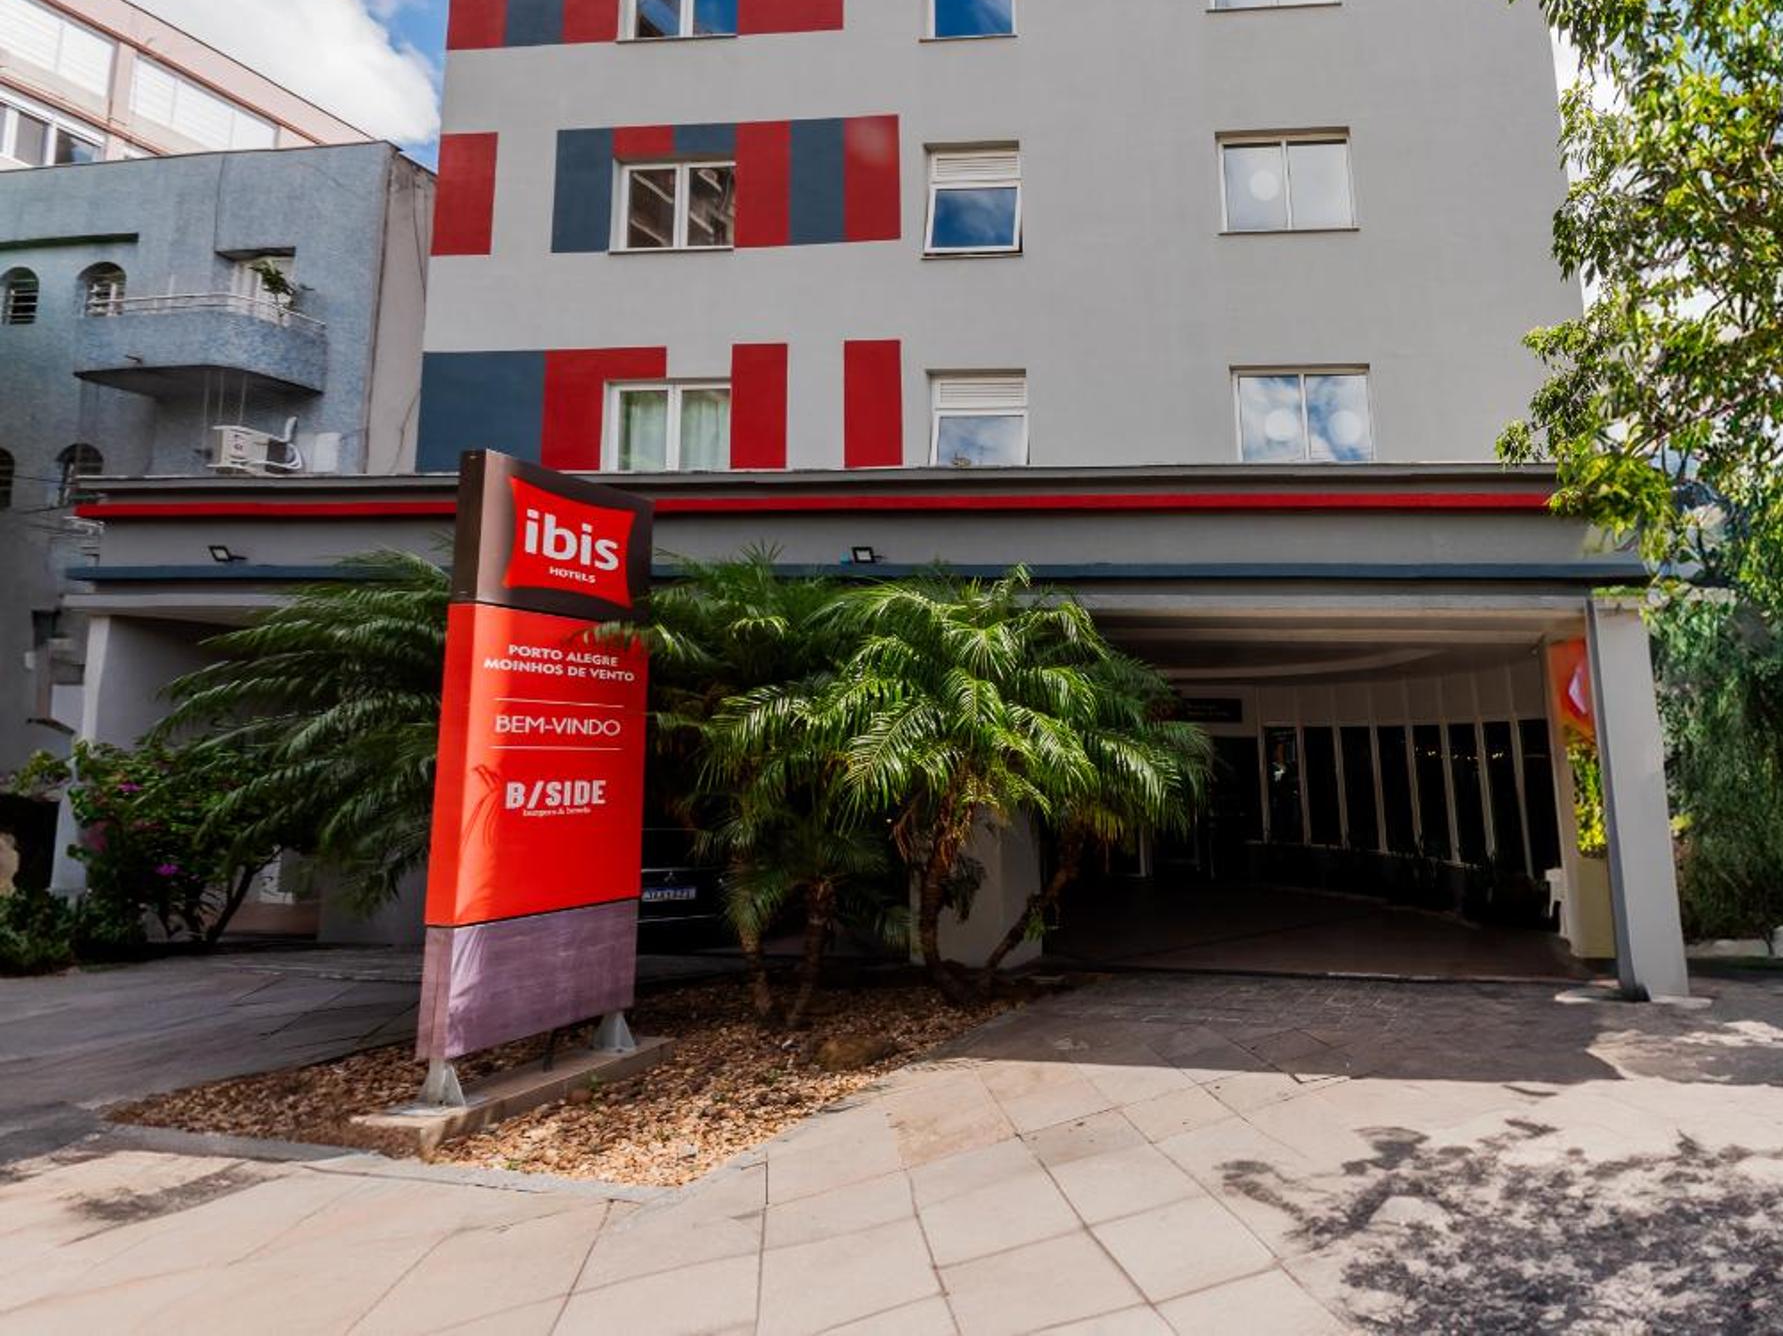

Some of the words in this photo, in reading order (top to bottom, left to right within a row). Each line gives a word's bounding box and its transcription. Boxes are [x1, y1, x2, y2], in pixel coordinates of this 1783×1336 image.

[524, 508, 619, 571] ibis
[549, 566, 596, 584] HOTELS
[508, 644, 563, 660] PORTO
[566, 651, 619, 667] ALEGRE
[483, 658, 564, 676] MOINHOS
[567, 667, 587, 678] DE
[589, 668, 635, 682] VENTO
[495, 715, 621, 737] BEM-VINDO
[505, 779, 607, 810] B/SIDE
